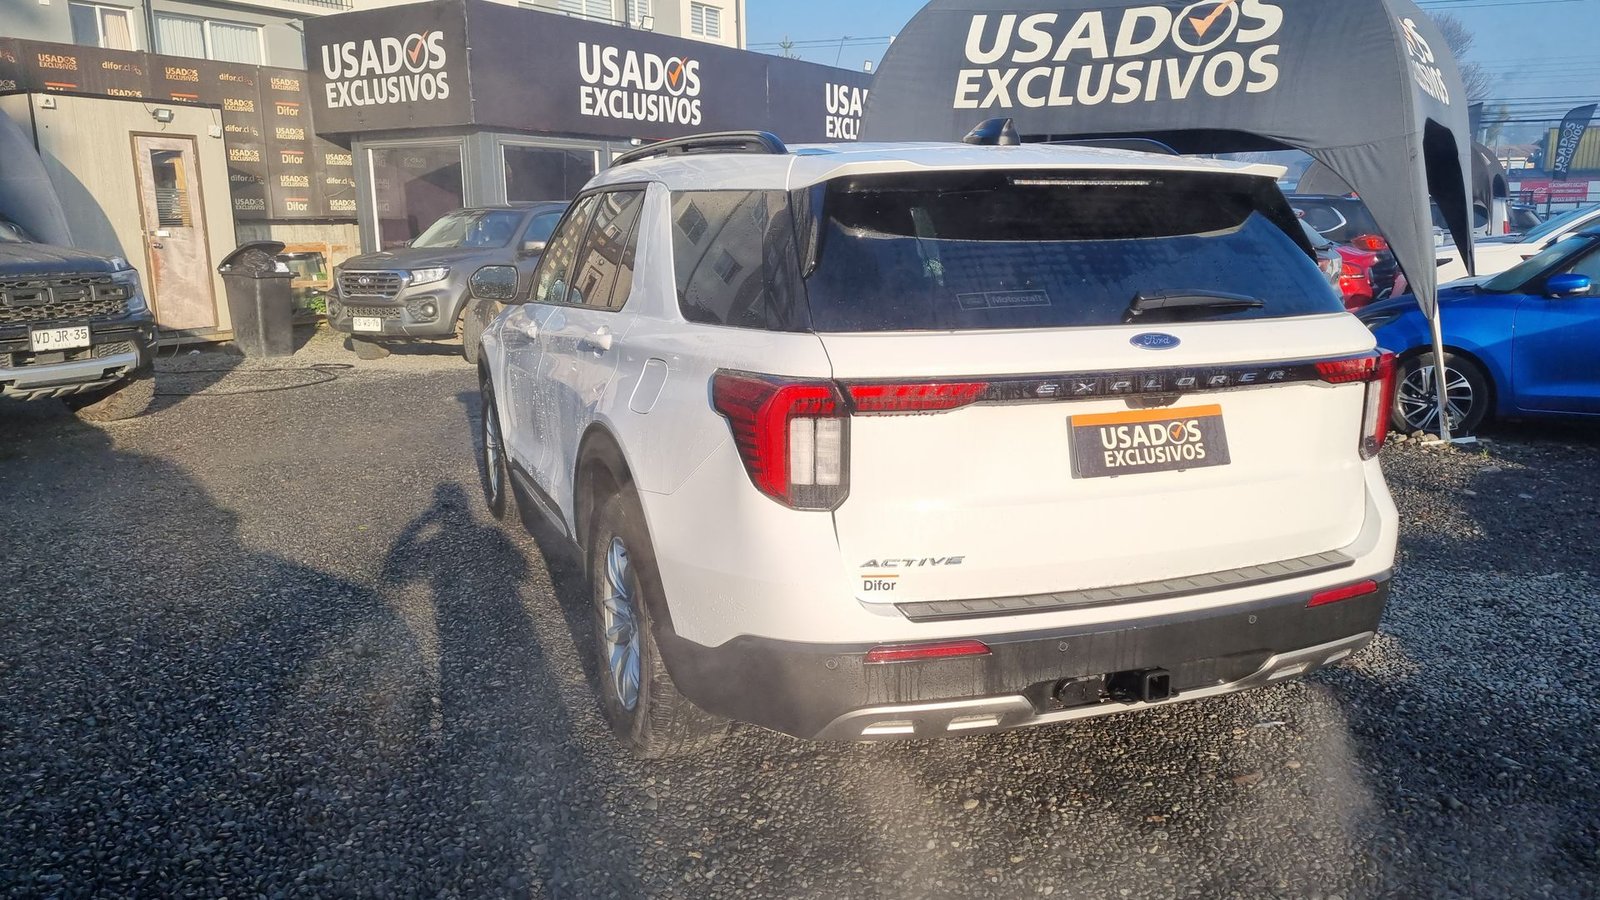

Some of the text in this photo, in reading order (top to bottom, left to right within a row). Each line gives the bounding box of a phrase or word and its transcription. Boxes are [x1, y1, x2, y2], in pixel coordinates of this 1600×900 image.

[963, 0, 1285, 64] USADOS
[38, 53, 77, 65] USADOS
[321, 30, 446, 80] USADOS
[165, 66, 198, 76] USADOS
[577, 42, 701, 97] USADOS
[270, 78, 300, 86] USADOS
[953, 44, 1280, 109] EXCLUSIVOS
[325, 71, 450, 109] EXCLUSIVOS
[224, 98, 254, 107] USADOS
[579, 90, 702, 126] EXCLUSIVOS
[277, 106, 299, 116] Difor
[276, 127, 304, 136] USADOS
[230, 148, 259, 156] USADOS
[1555, 122, 1576, 171] USADOS
[282, 154, 303, 164] Difor
[326, 153, 352, 161] USADOS
[280, 175, 308, 183] USADOS
[286, 202, 308, 211] Difor
[1036, 370, 1285, 395] EXPLORER
[1100, 420, 1202, 449] USADOS
[1104, 442, 1206, 467] EXCLUSIVOS
[860, 556, 965, 567] ACTIVE
[863, 580, 896, 591] Difor
